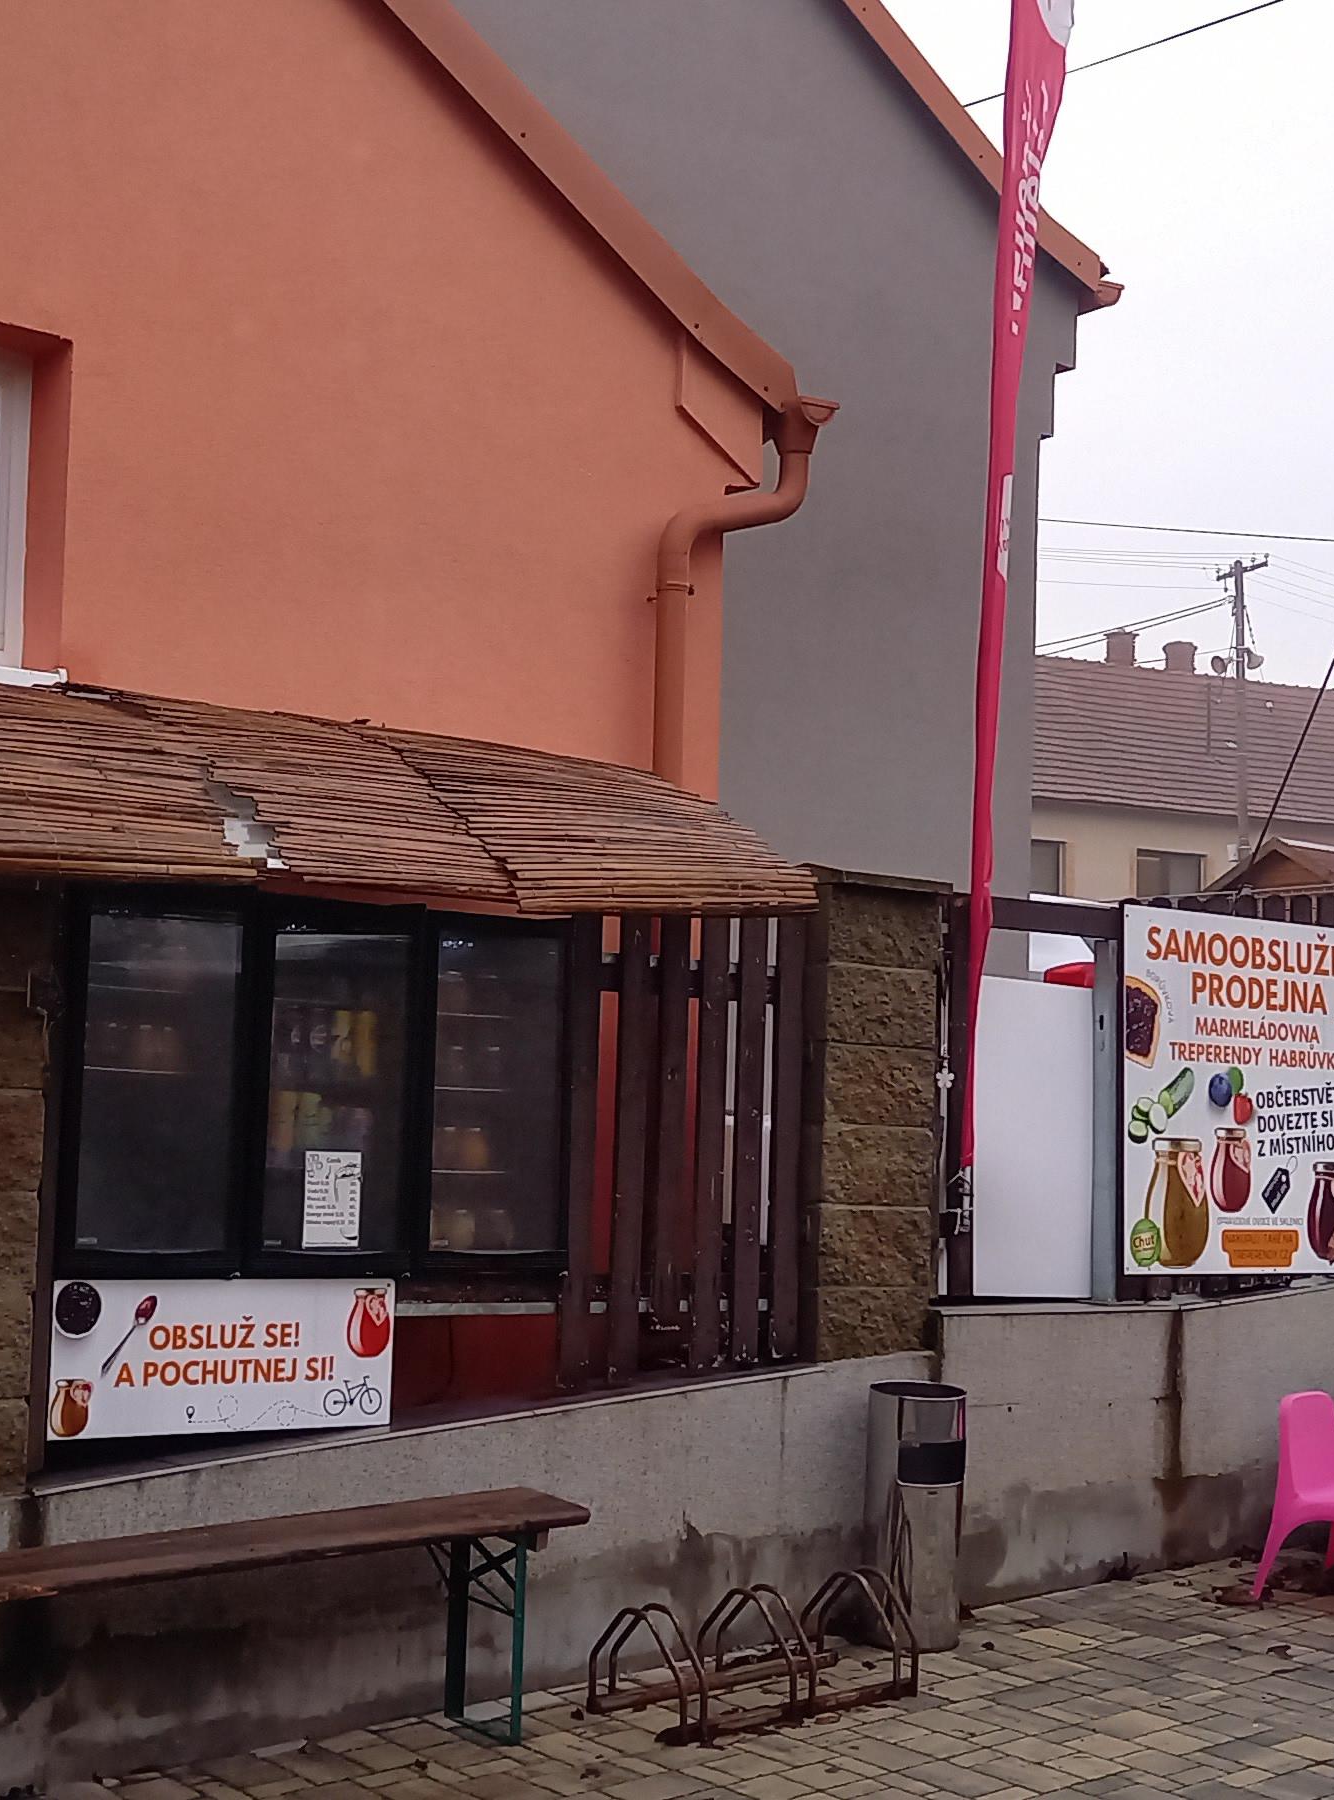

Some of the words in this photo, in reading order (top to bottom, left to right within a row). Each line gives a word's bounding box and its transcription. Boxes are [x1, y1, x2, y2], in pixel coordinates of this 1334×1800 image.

[1192, 972, 1327, 1014] PRODEJNA
[1195, 1016, 1320, 1043] MARMELÁDOVNA
[1169, 1041, 1262, 1065] TREPERENDY
[1258, 1110, 1318, 1133] DOVEZTE
[1322, 1110, 1333, 1127] SI
[1257, 1140, 1265, 1157] Z
[1270, 1133, 1334, 1156] MÍSTNÍHO
[1133, 1235, 1154, 1248] Chut
[149, 1315, 255, 1350] OBSLUŽ
[263, 1322, 299, 1348] SE!
[113, 1362, 135, 1388] A
[143, 1358, 297, 1386] POCHUTNEJ
[305, 1356, 334, 1381] SI!
